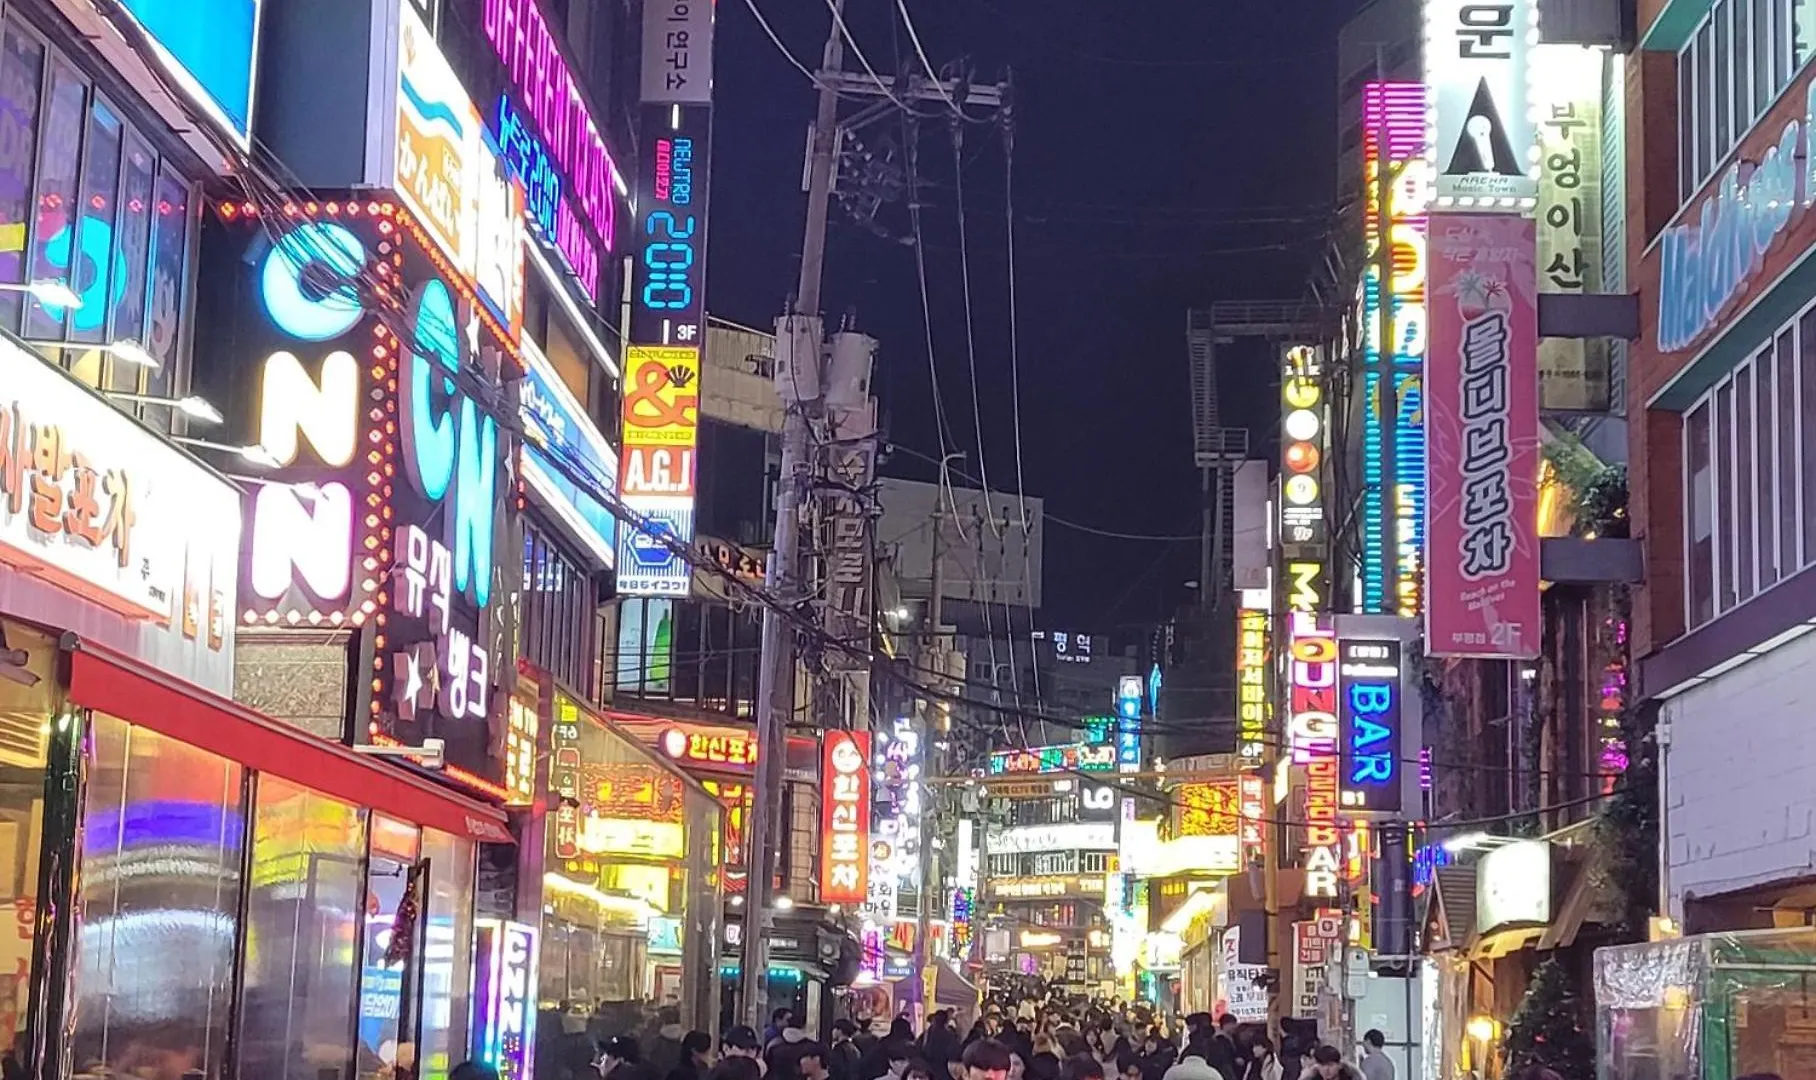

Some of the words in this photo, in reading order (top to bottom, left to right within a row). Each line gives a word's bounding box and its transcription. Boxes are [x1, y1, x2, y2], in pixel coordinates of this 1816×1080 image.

[666, 30, 690, 91] 연구소
[643, 211, 695, 310] 2010
[677, 324, 697, 342] 3F
[1490, 622, 1523, 645] 2F
[1350, 683, 1393, 785] BAR
[831, 773, 861, 892] 한신포차
[501, 929, 527, 1034] CNN
